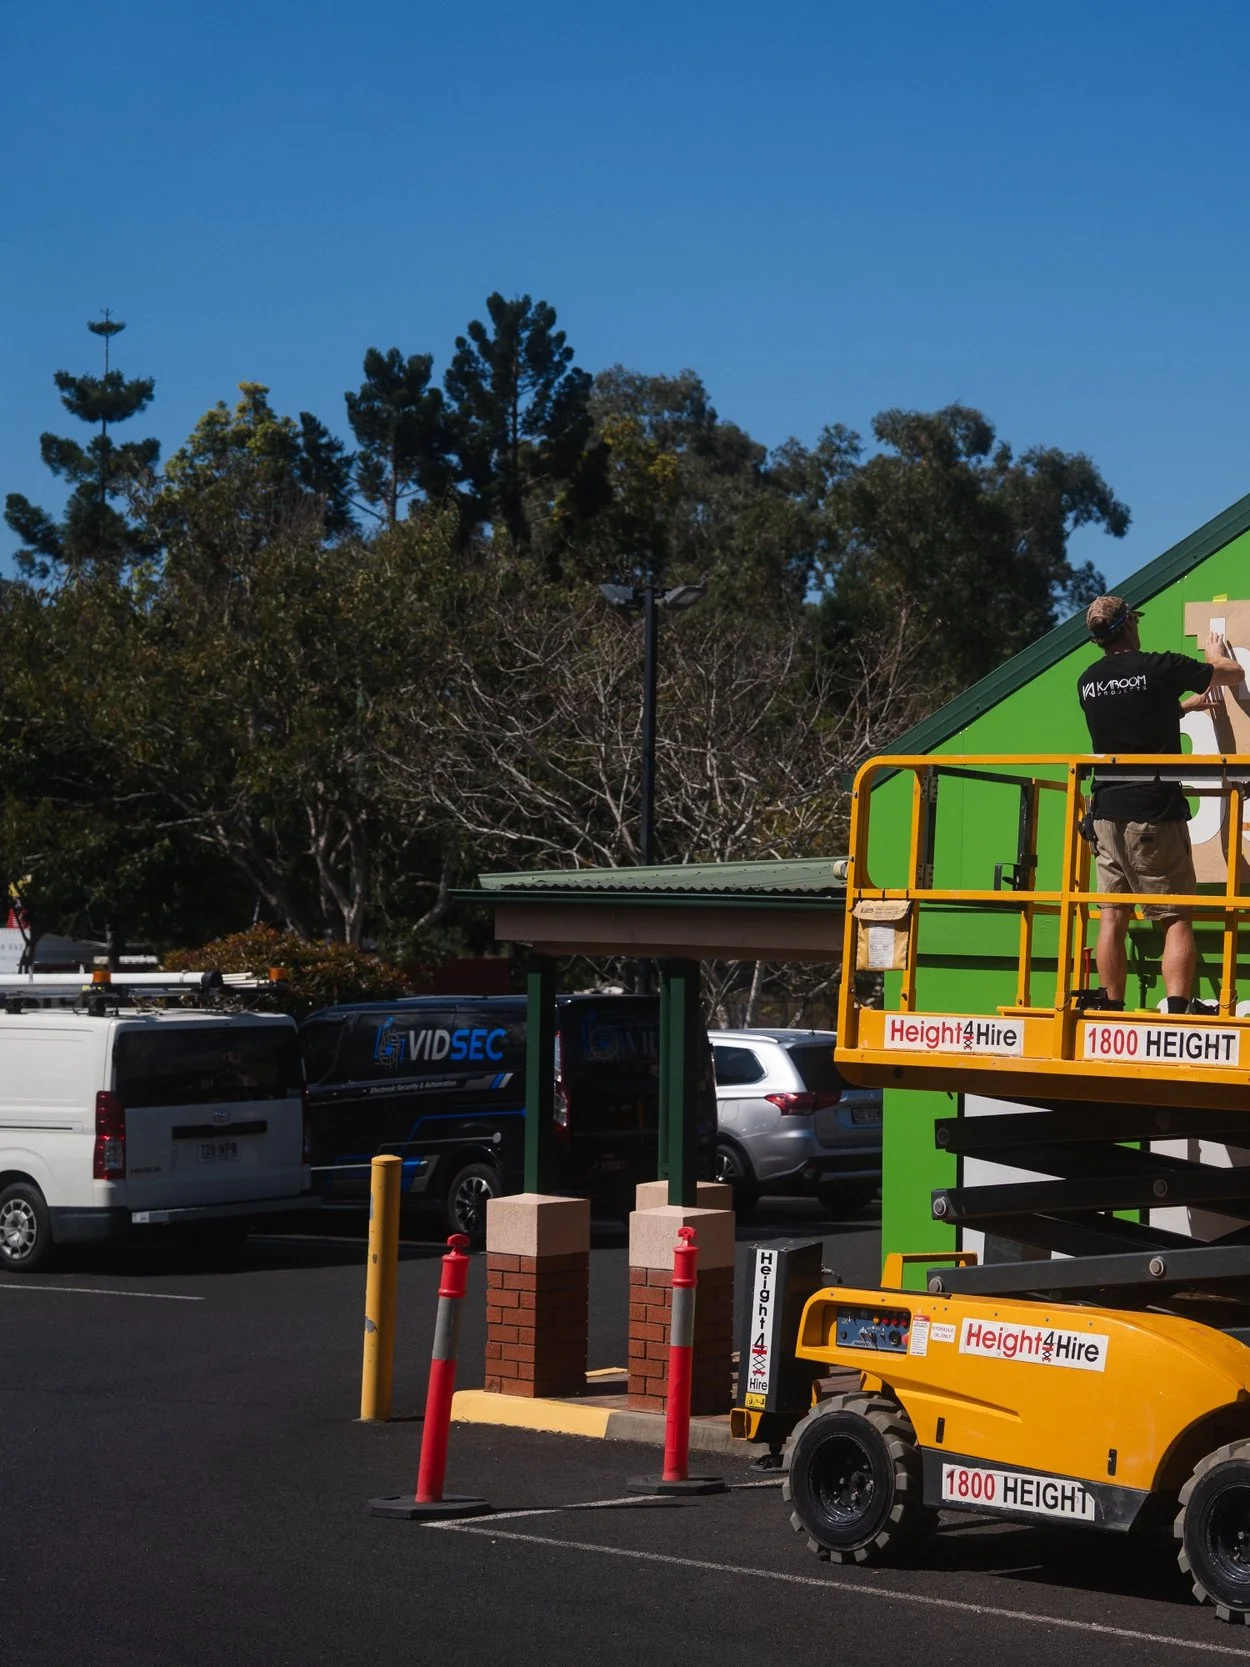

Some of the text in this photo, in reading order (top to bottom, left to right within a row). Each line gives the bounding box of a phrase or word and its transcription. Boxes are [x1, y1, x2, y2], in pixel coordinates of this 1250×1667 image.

[1097, 685, 1147, 697] PROJECTS
[409, 1029, 507, 1061] VIDSEC
[1088, 1028, 1237, 1061] 1800 HEIGHT
[750, 1377, 768, 1391] Hire
[946, 1469, 1088, 1514] 1800 HEIGHT
